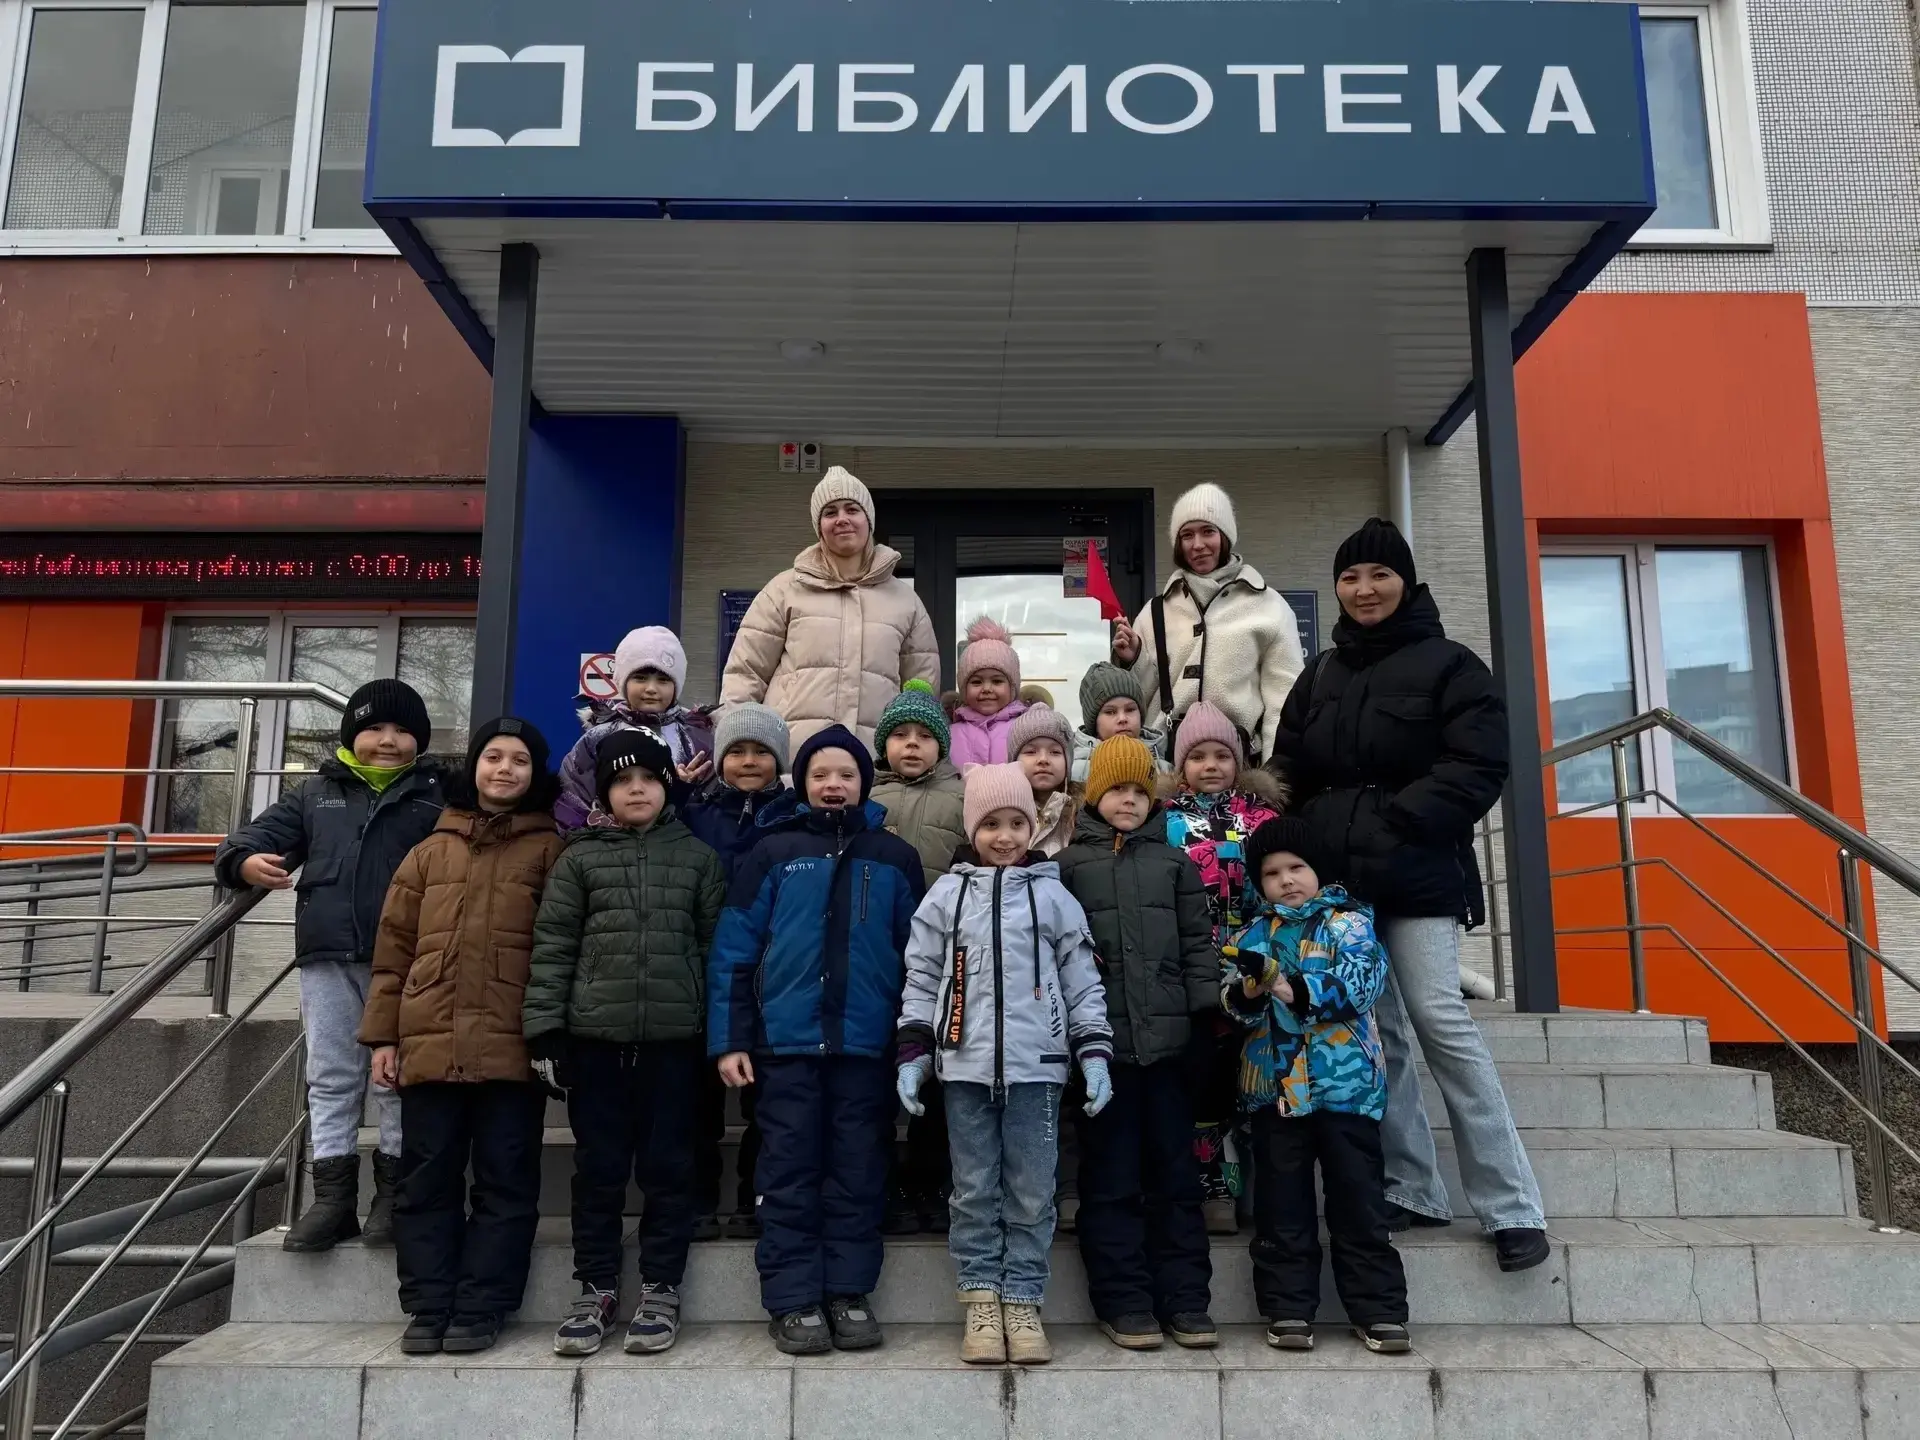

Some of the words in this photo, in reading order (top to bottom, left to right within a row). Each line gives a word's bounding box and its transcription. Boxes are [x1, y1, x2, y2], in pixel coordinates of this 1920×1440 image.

[635, 61, 1598, 135] БИБЛИОТЕКА
[349, 554, 409, 576] 9:00
[956, 951, 964, 991] DON'T
[952, 993, 963, 1023] GIVE
[950, 1025, 960, 1043] UP
